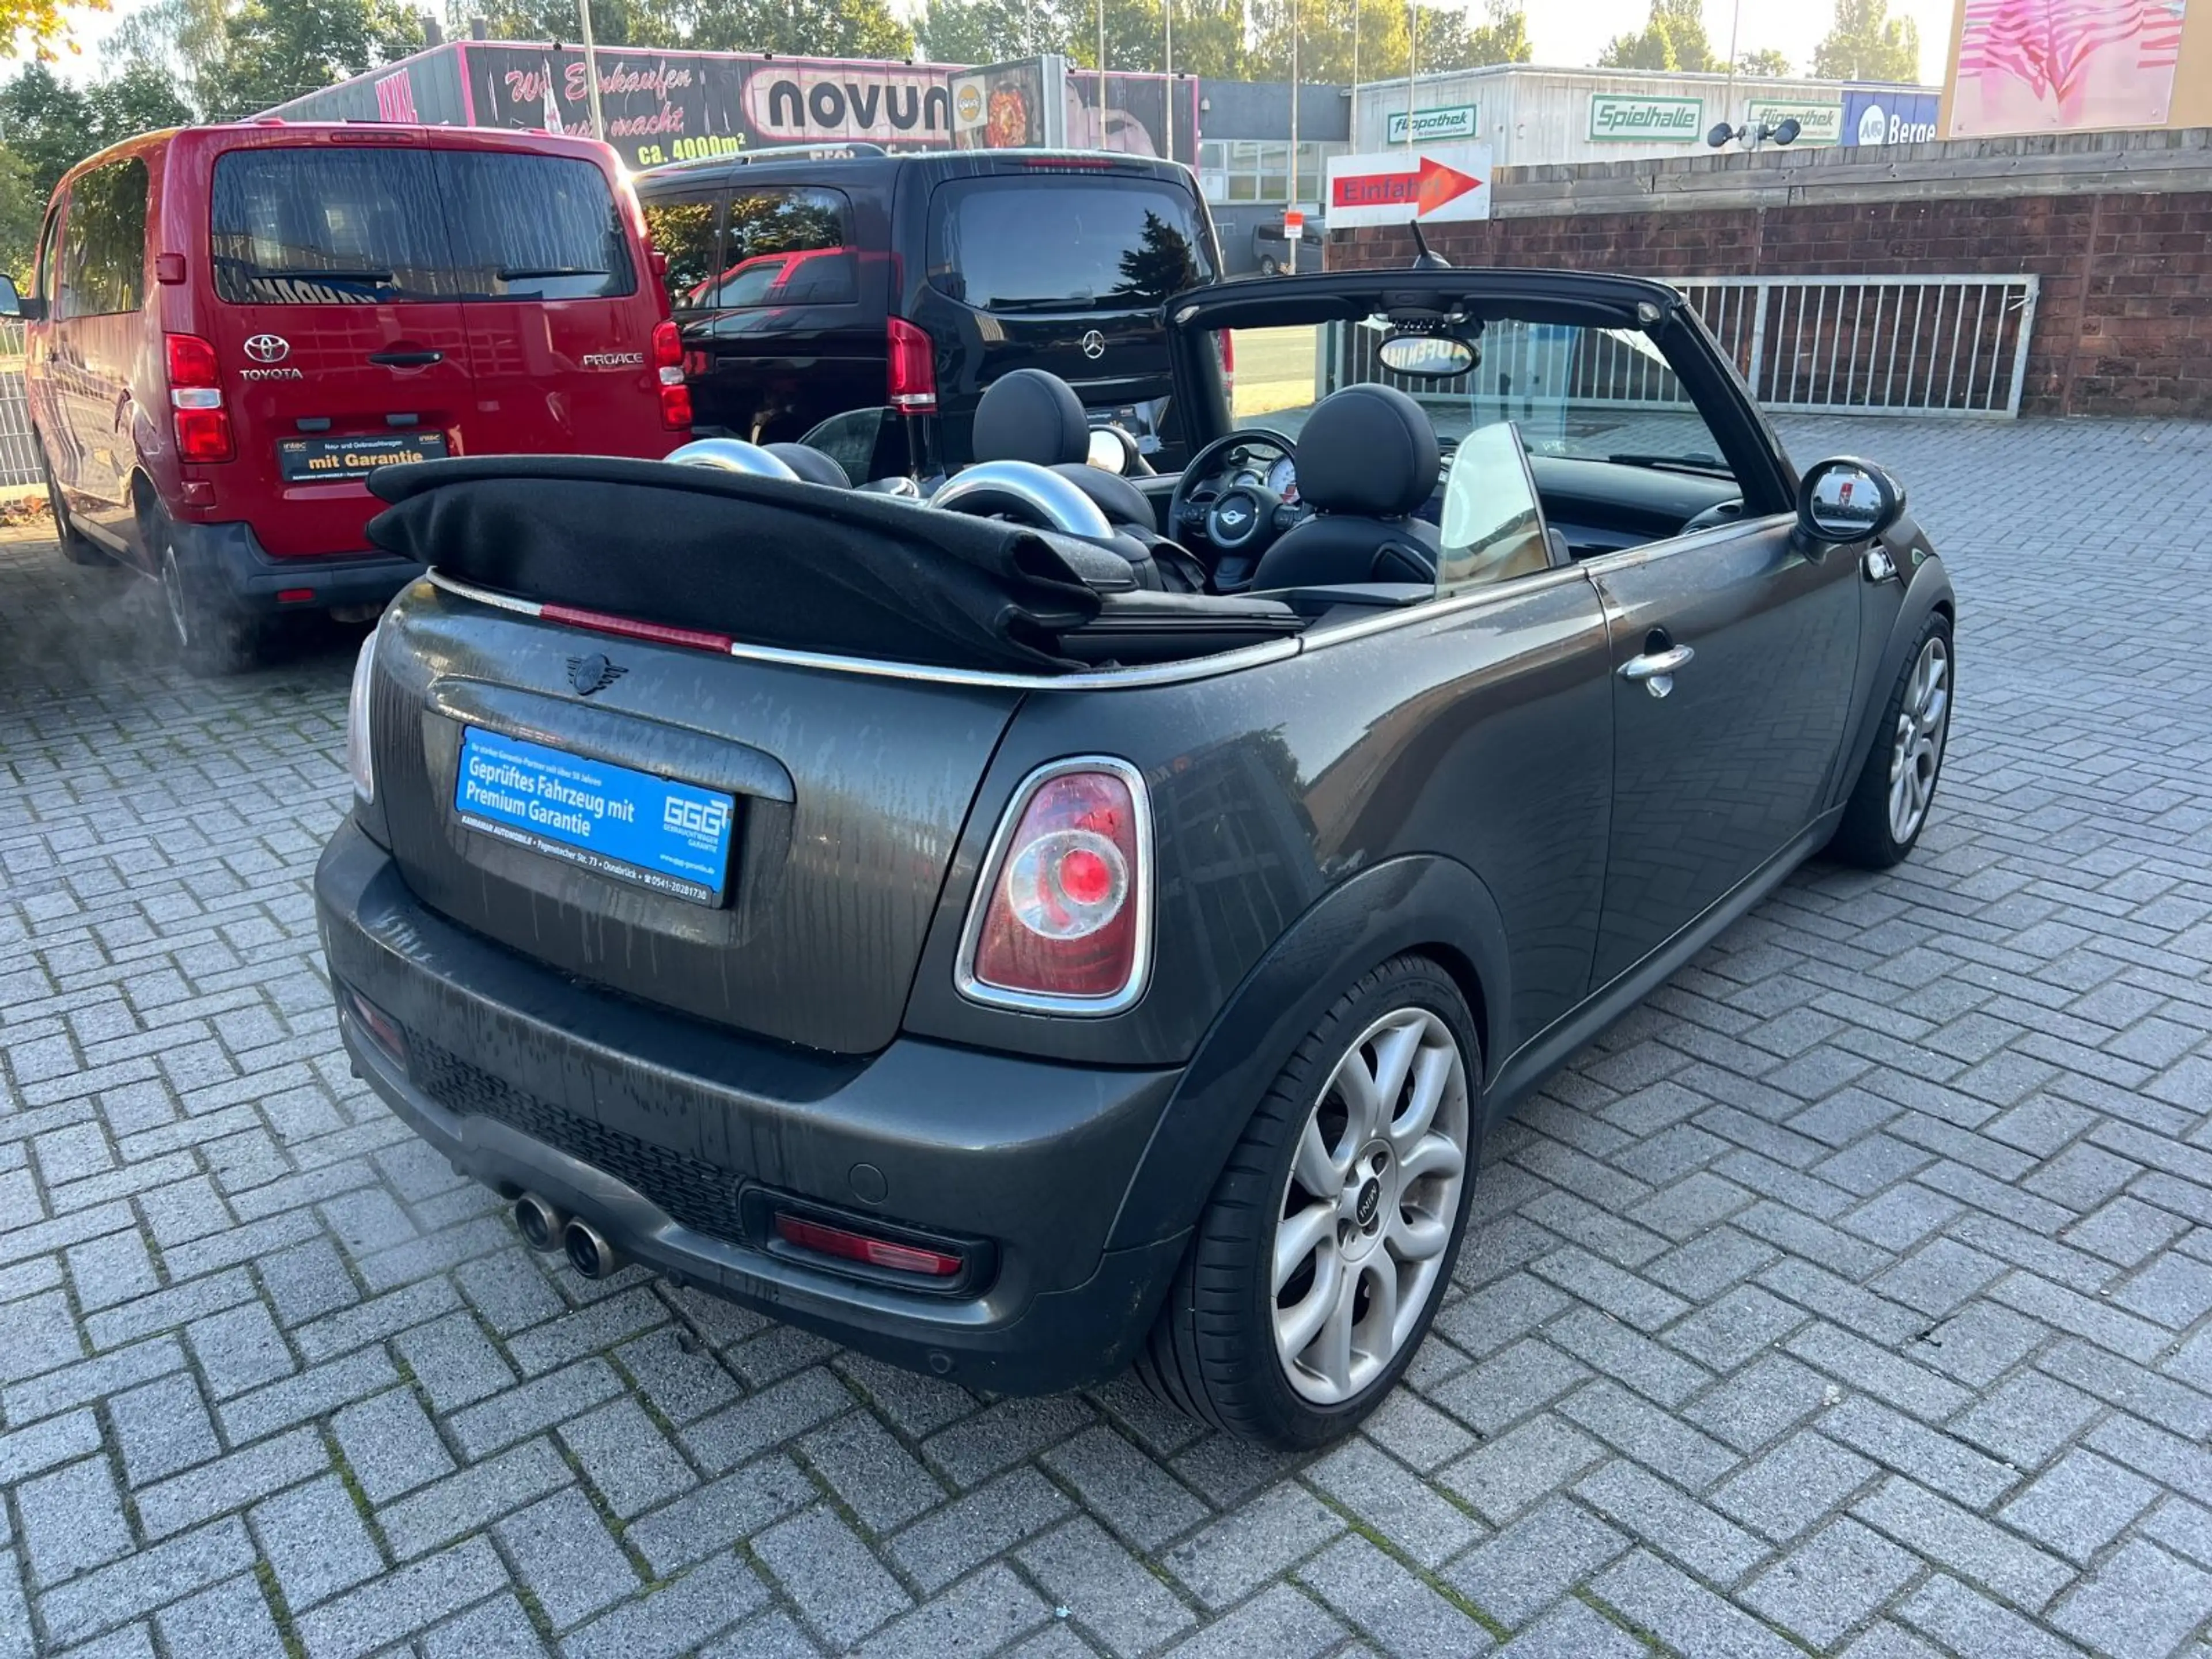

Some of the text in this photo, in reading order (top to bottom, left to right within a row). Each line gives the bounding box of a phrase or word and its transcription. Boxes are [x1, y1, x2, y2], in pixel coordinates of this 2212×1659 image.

[565, 58, 692, 101] Enkaufen
[1596, 104, 1696, 131] Spielhalle
[638, 144, 669, 165] ca.
[583, 353, 644, 365] PROACE
[239, 368, 304, 381] TOYOTA
[308, 449, 423, 469] mit Garantie
[469, 755, 635, 823] Geprüftes Fahrzeug mit
[465, 779, 592, 837] Premium Garantie
[664, 796, 722, 837] GGG
[589, 856, 597, 867] 73
[603, 861, 637, 880] Osnabrück
[1359, 1185, 1378, 1218] MINI
